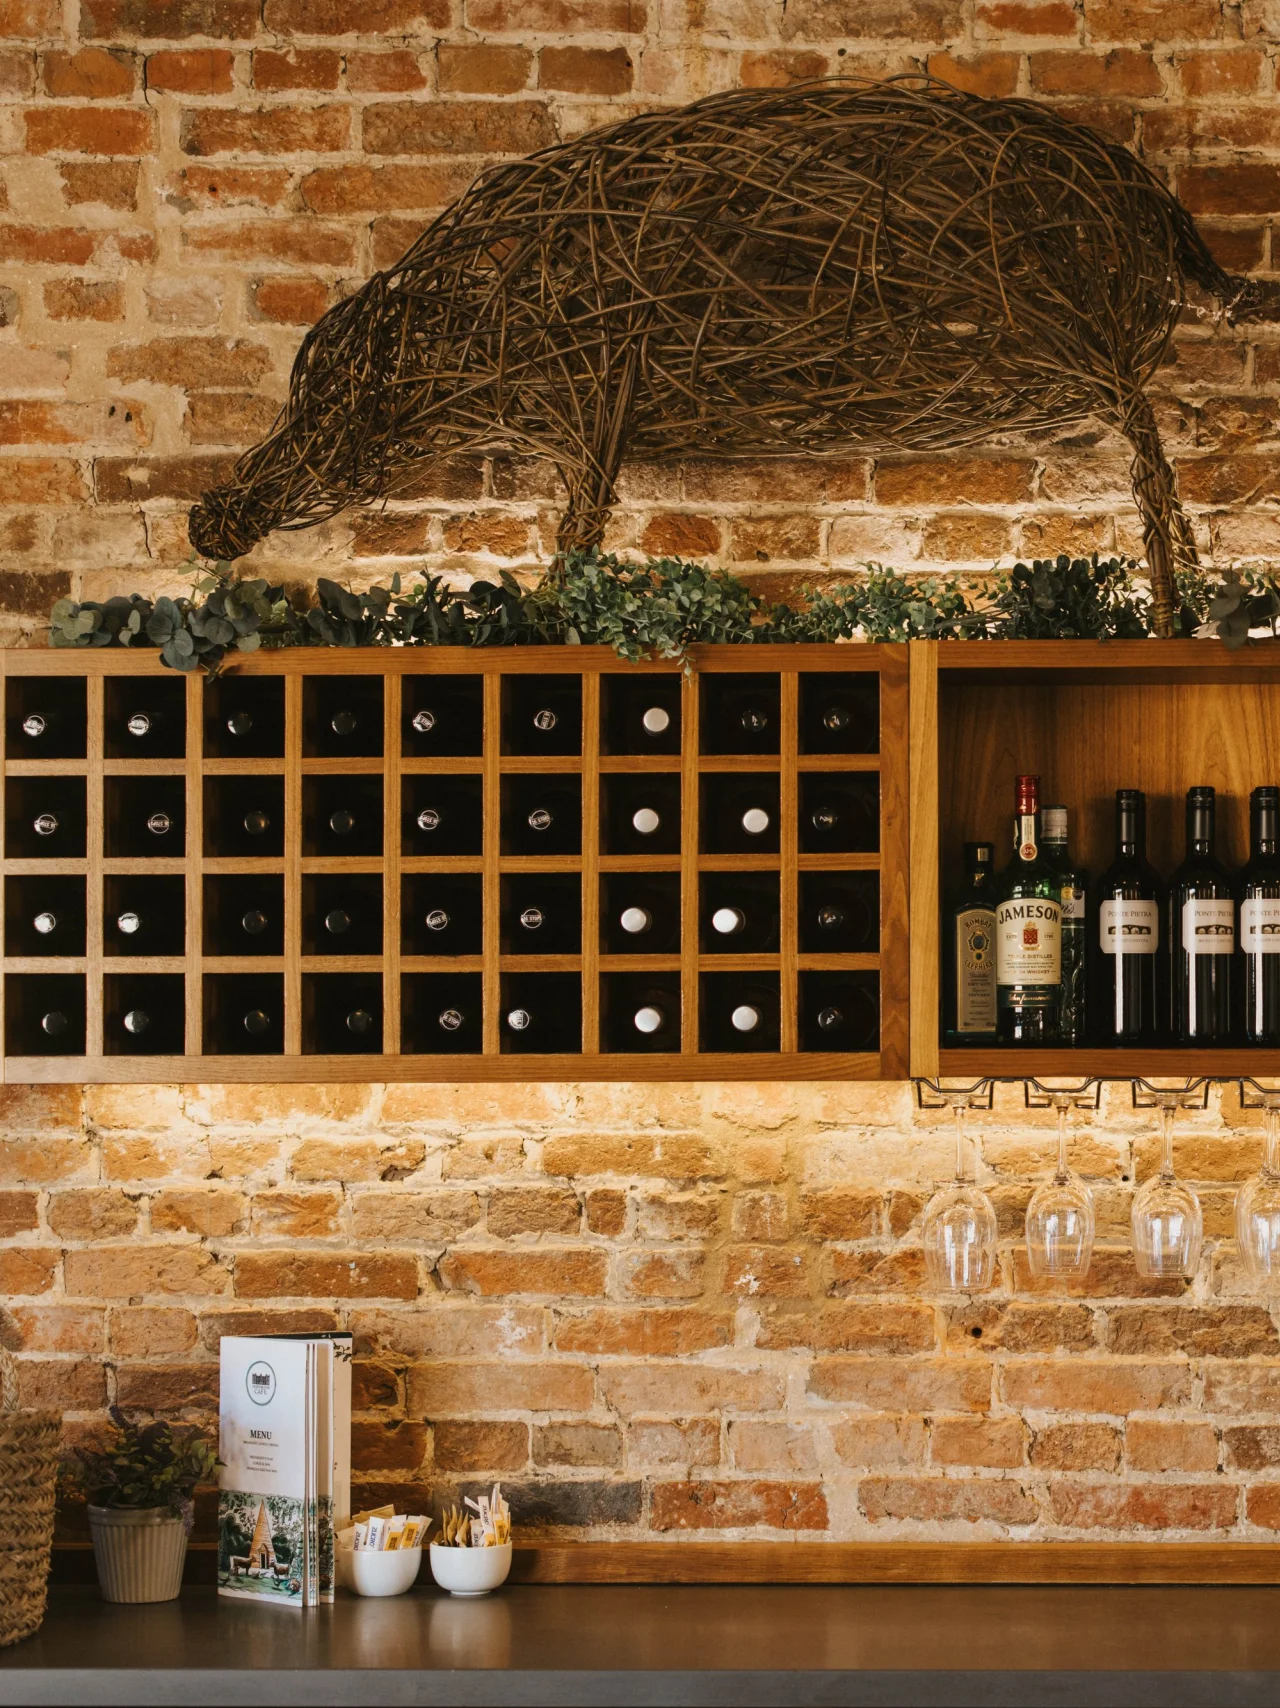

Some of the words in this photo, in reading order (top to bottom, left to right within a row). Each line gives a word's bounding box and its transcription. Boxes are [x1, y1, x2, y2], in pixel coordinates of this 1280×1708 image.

[999, 906, 1058, 924] JAMESON
[964, 918, 992, 929] BOMBAY
[964, 960, 994, 970] SAPPHIRE
[250, 1430, 272, 1440] MENU
